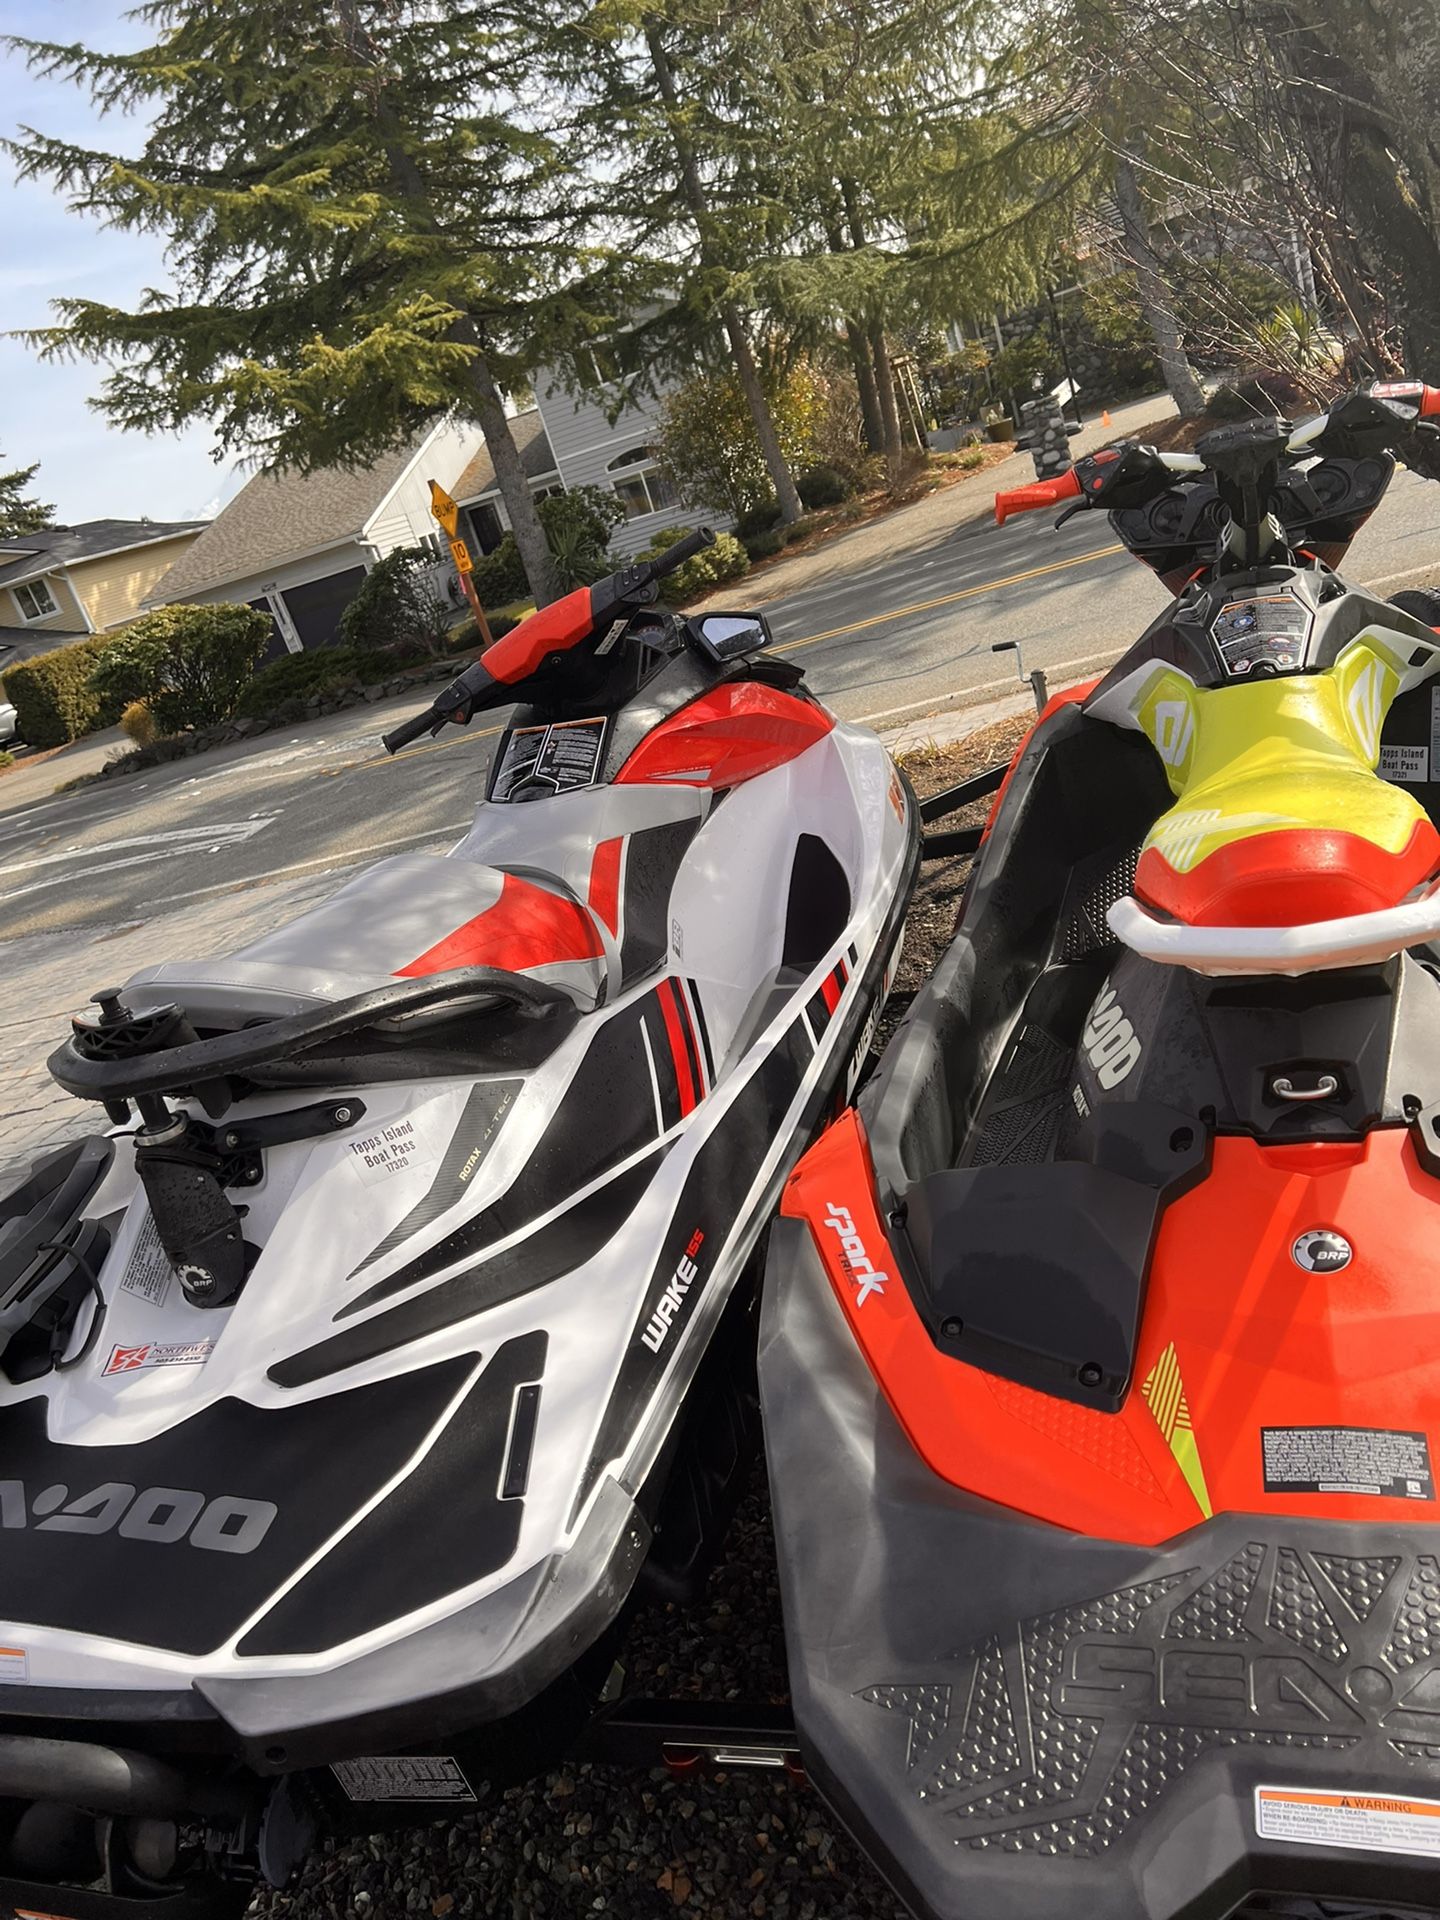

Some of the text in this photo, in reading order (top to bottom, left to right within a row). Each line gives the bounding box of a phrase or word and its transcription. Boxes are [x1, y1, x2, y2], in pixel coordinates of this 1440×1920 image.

[434, 501, 455, 519] BUMP
[453, 543, 466, 560] 10
[1380, 747, 1424, 759] Tapps Island
[1382, 759, 1418, 770] Boat Pass
[349, 1120, 414, 1156] Tapps Island
[363, 1139, 416, 1169] Boat Pass
[385, 1157, 409, 1173] 17320
[459, 1147, 482, 1181] ROTAX
[1316, 1250, 1349, 1261] BRP
[193, 1278, 213, 1287] BRP
[641, 1228, 705, 1354] WAKE 155
[1263, 1800, 1283, 1808] AVOID
[1283, 1802, 1310, 1811] SERIOUS
[1311, 1804, 1333, 1813] INJURY
[1354, 1798, 1412, 1813] WARNING
[1263, 1812, 1282, 1820] WHEN
